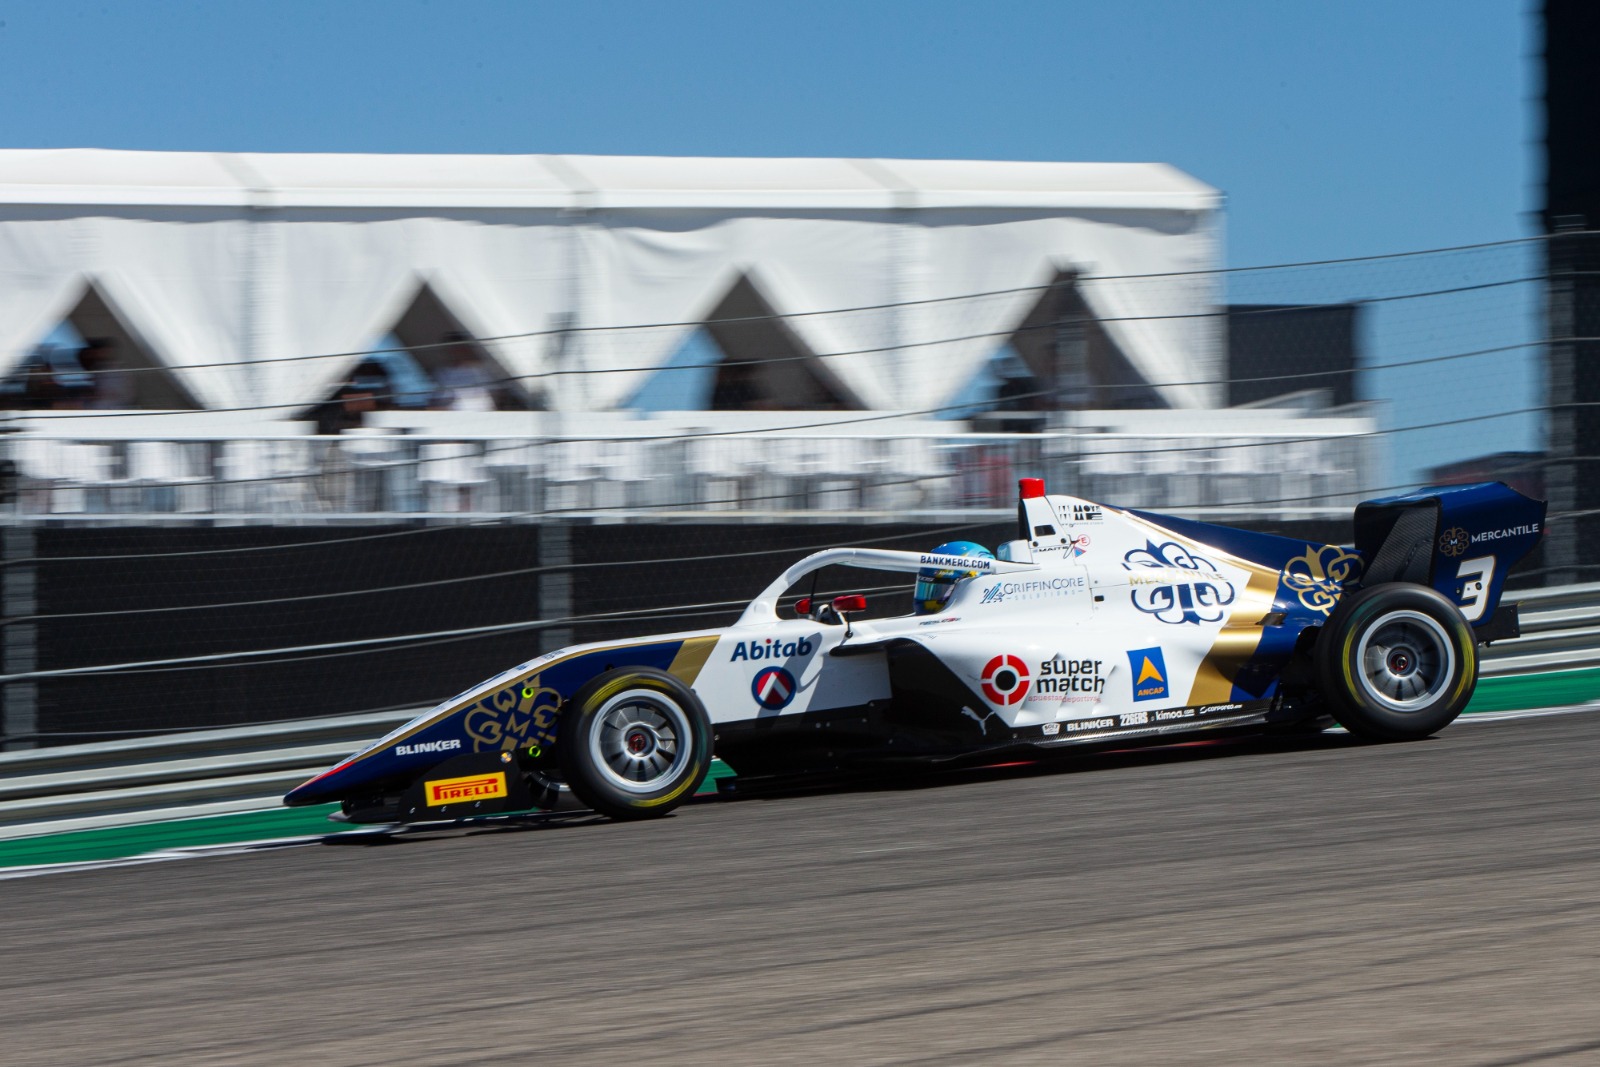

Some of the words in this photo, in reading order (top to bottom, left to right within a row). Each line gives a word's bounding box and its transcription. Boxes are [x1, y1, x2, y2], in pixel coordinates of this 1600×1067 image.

[1471, 523, 1540, 543] MERCANTILE
[920, 555, 990, 569] BANKMERC.COM
[1456, 556, 1495, 622] 3
[730, 636, 812, 662] Abitab
[1040, 660, 1102, 677] super
[1036, 675, 1105, 695] match
[1137, 687, 1164, 696] ANCAP
[1066, 719, 1114, 731] BLINKER
[396, 739, 461, 756] BLINKER
[433, 778, 498, 801] PIRELLI
